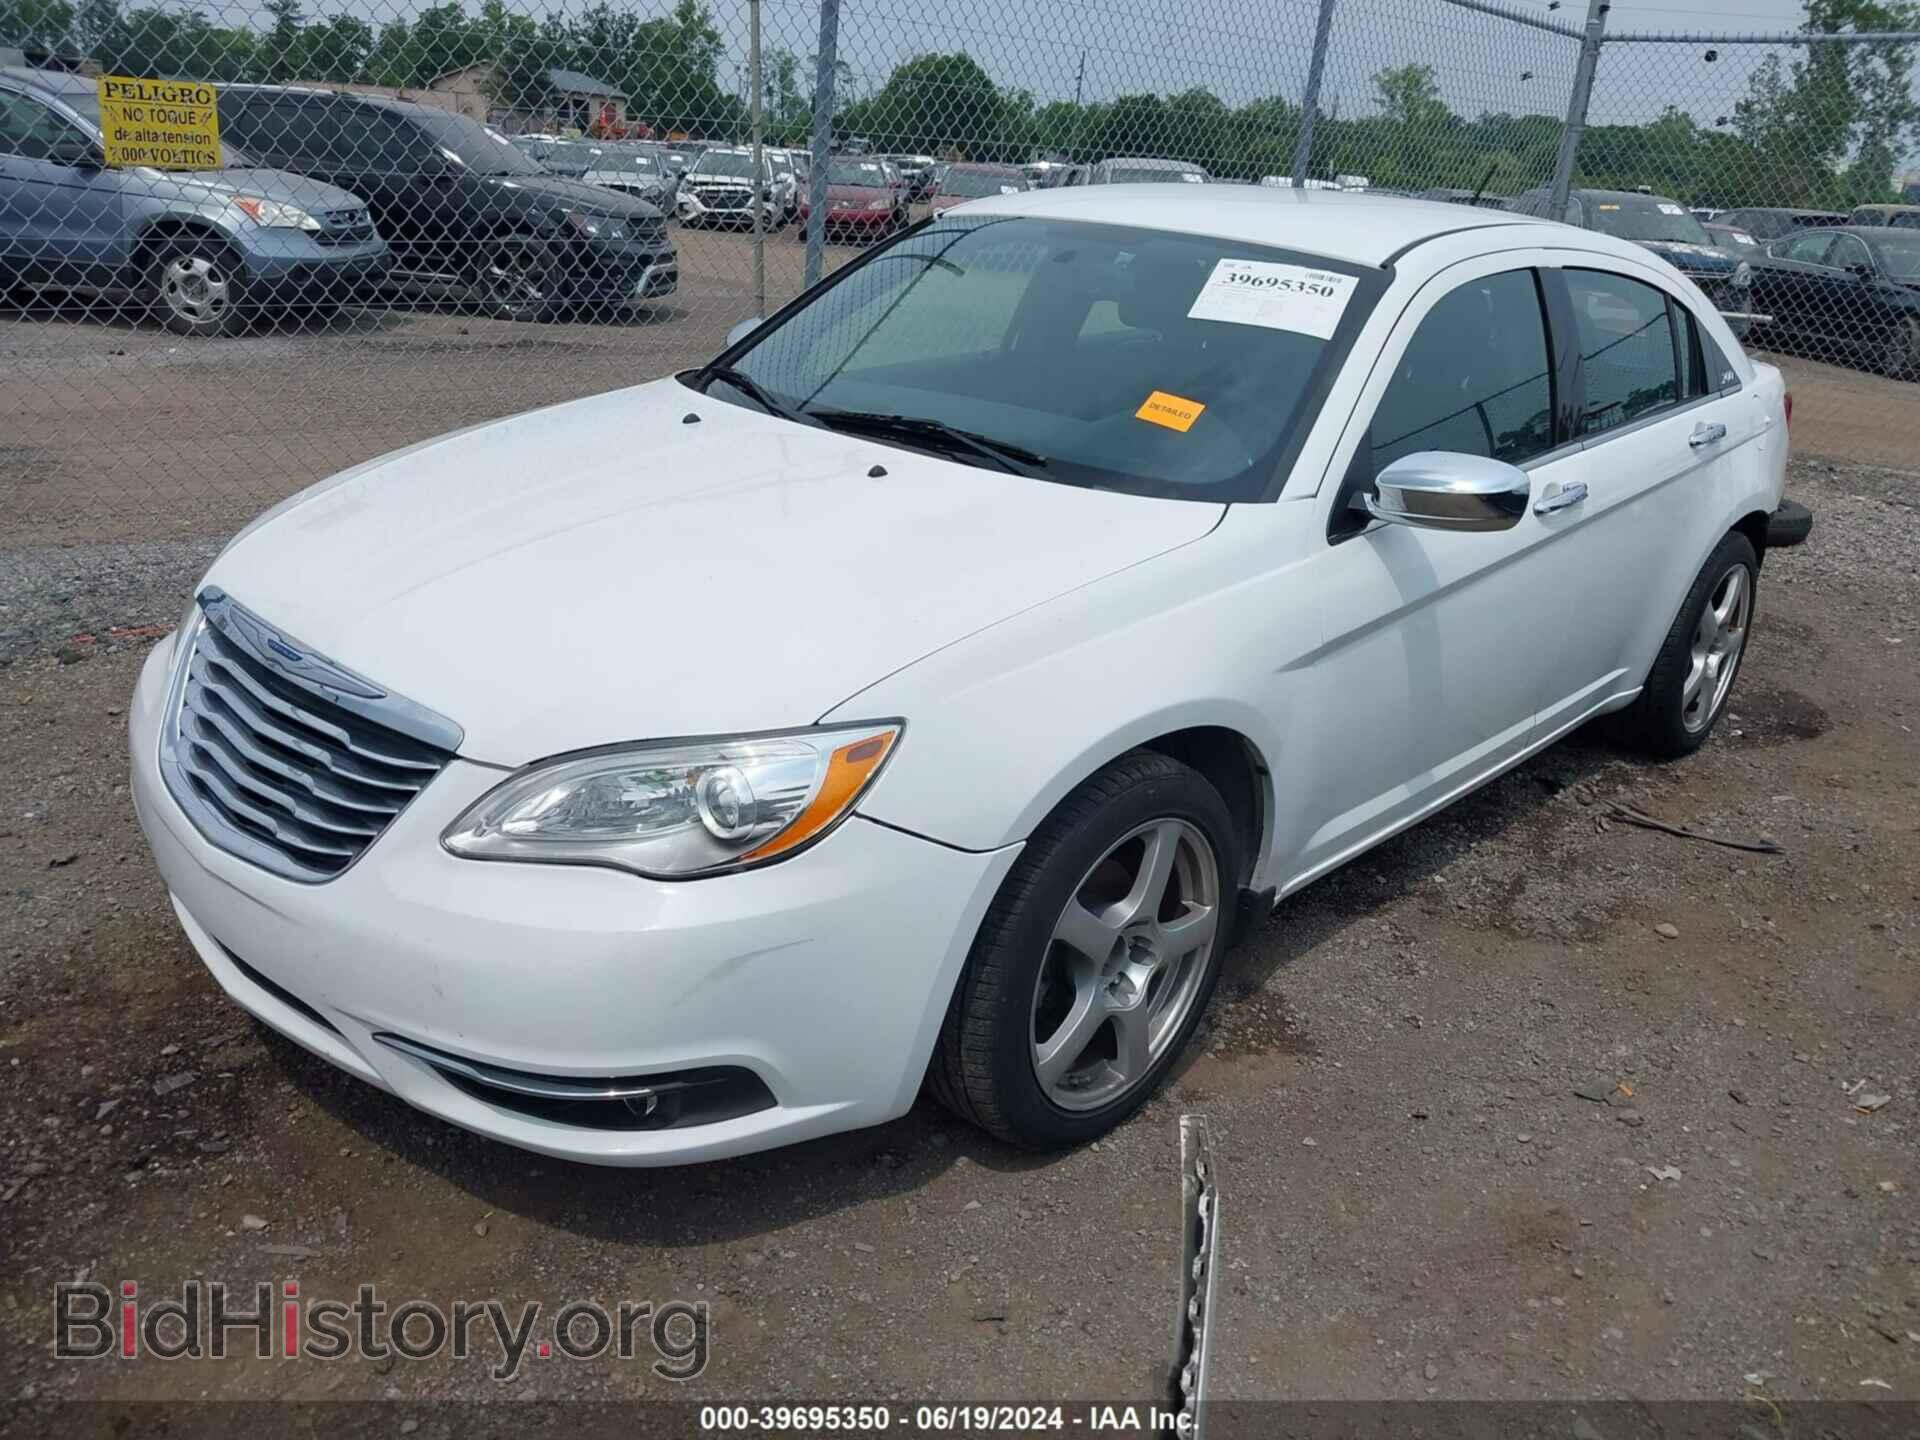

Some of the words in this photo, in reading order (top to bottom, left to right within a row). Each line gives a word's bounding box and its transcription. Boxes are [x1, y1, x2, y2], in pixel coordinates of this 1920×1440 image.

[104, 82, 211, 104] PELIGRO
[122, 107, 144, 122] NO
[150, 109, 197, 125] TOQUE
[135, 128, 158, 143] alta
[1221, 272, 1335, 298] 39695350
